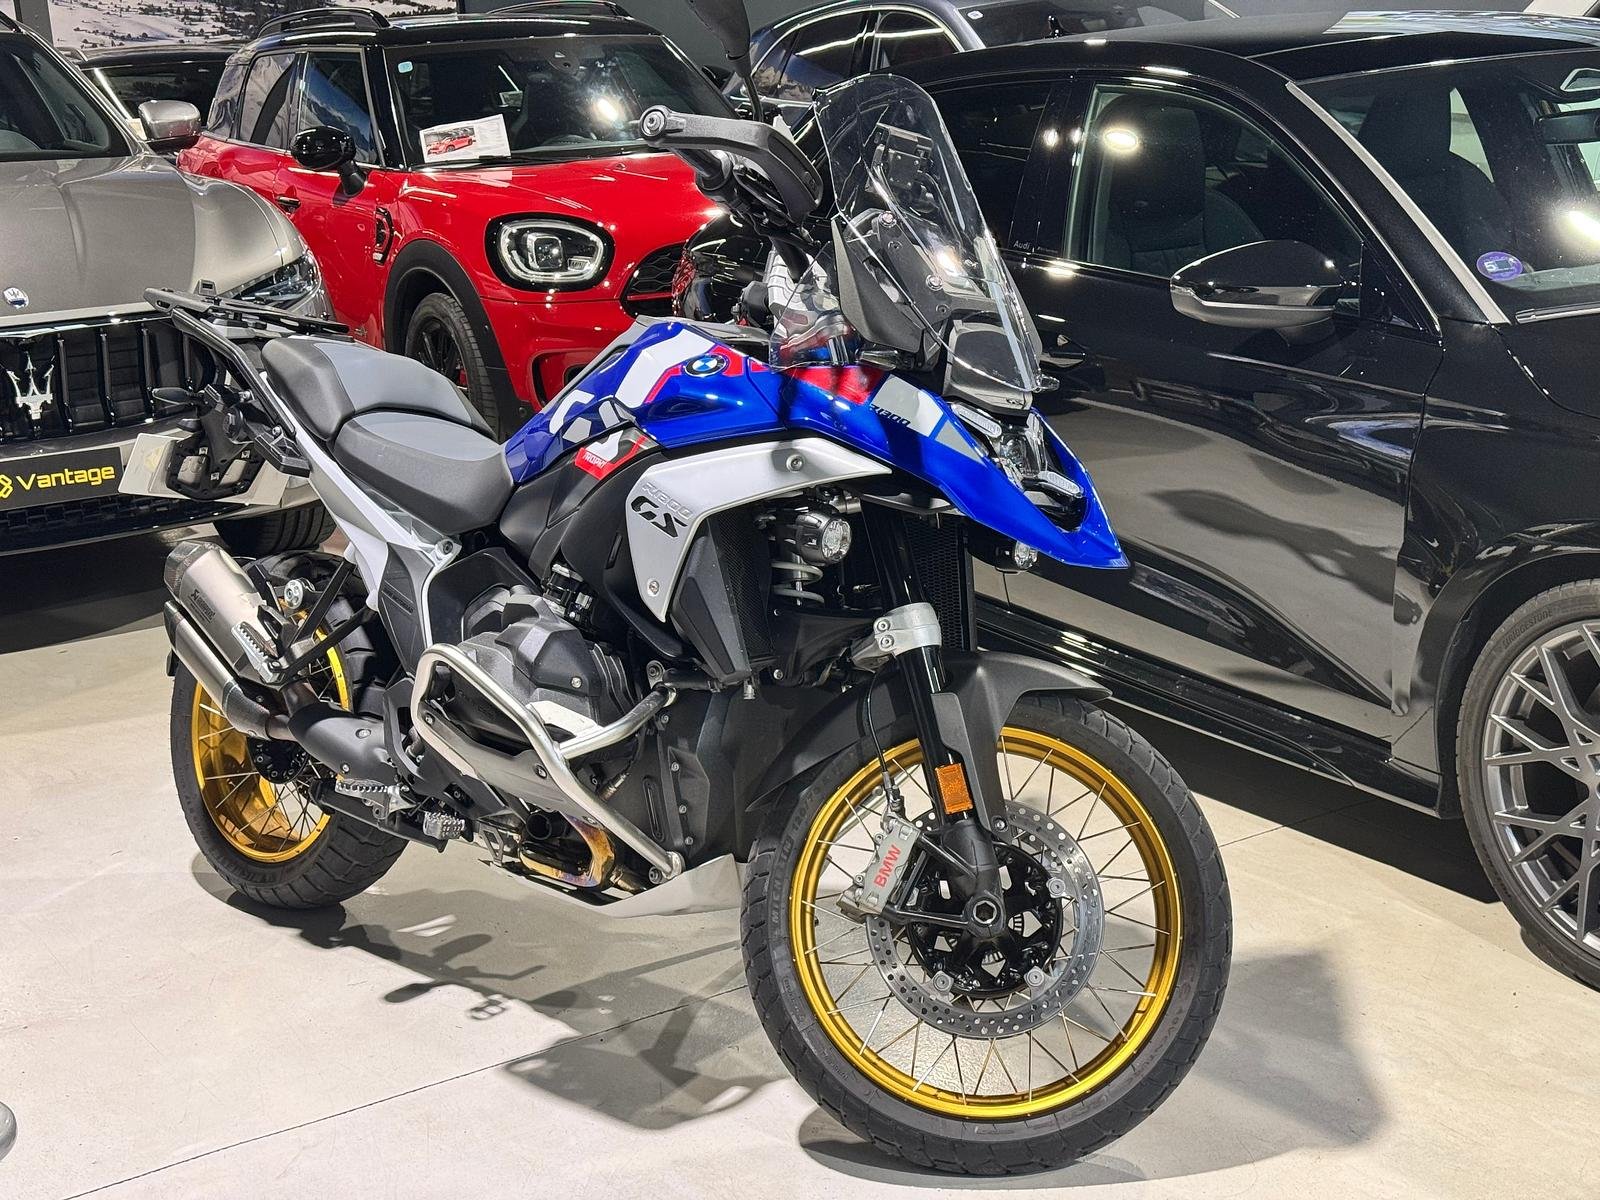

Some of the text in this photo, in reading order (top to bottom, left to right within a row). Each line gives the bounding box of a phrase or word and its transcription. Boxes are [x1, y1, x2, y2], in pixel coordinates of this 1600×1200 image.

[1013, 240, 1031, 250] Audi
[16, 466, 116, 490] Vantage
[630, 495, 689, 538] GS
[770, 836, 795, 925] MICHIN
[873, 844, 902, 888] BMW
